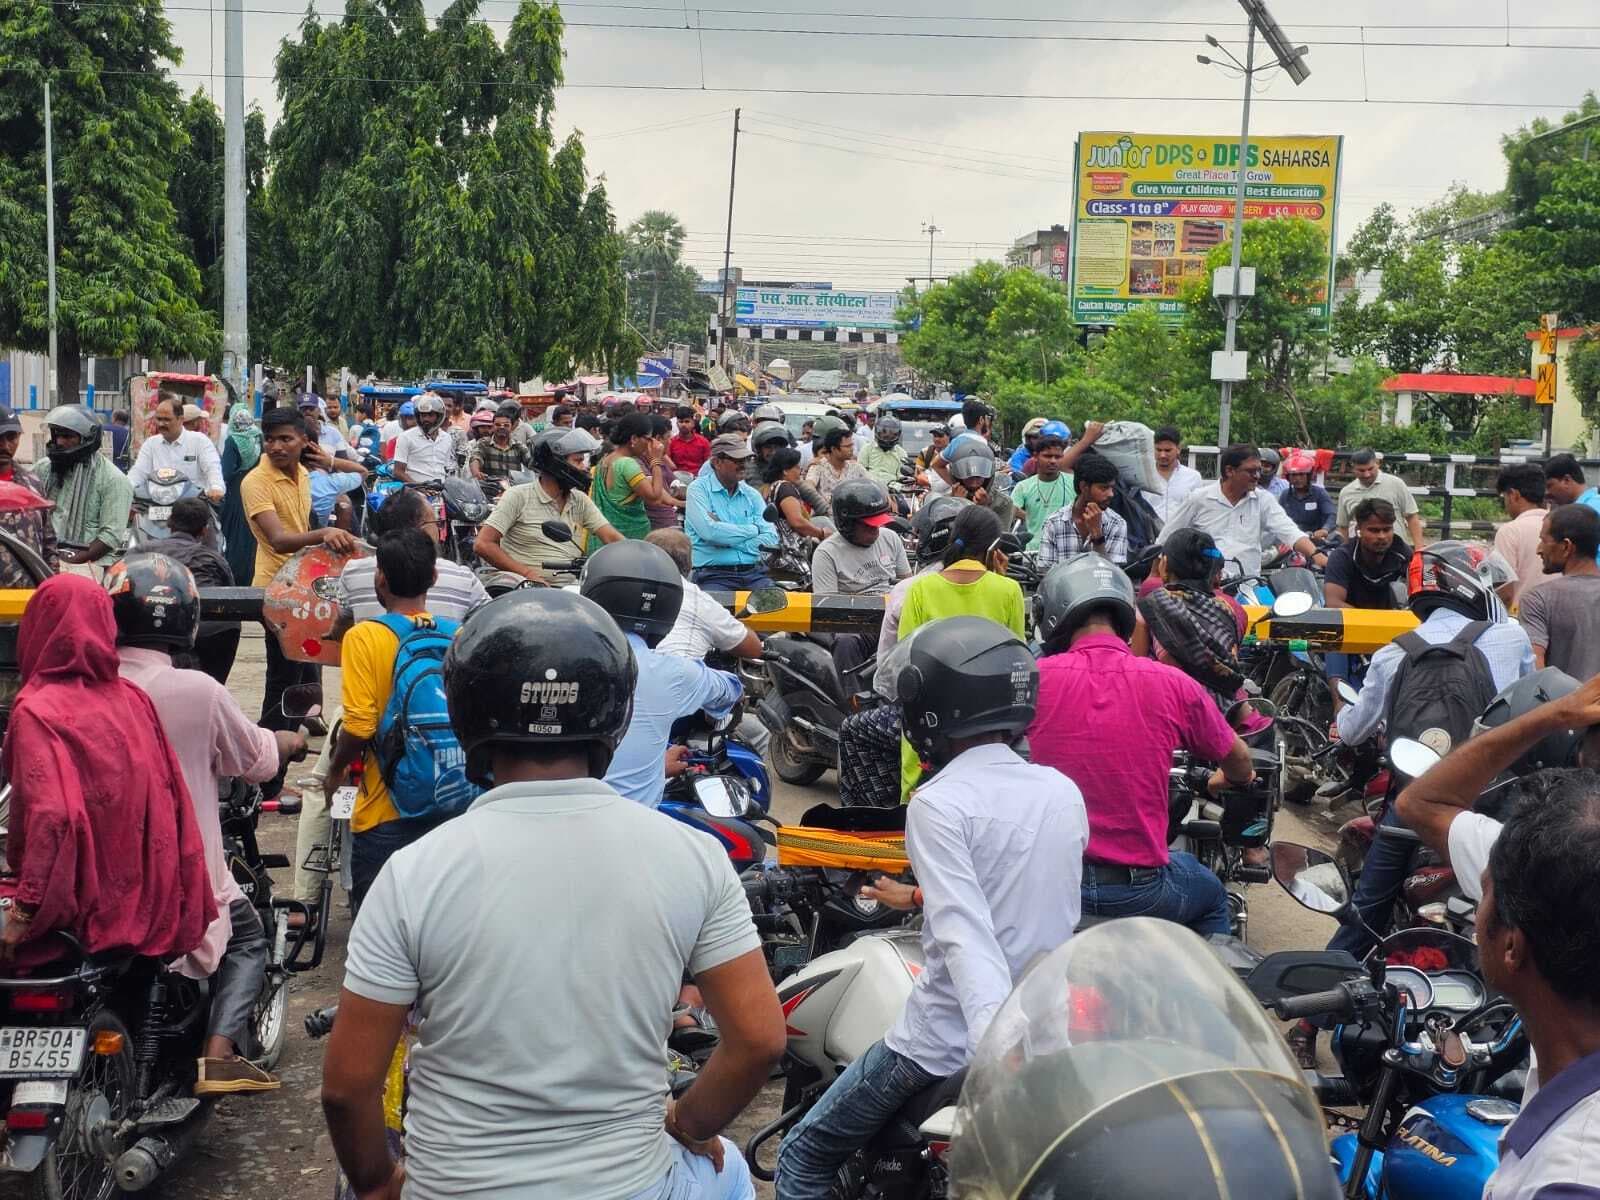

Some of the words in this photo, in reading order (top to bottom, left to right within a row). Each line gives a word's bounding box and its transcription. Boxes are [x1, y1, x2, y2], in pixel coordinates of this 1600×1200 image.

[1155, 143, 1194, 167] DPS
[1212, 143, 1259, 168] DPS
[1262, 149, 1330, 168] SAHARSA
[1175, 169, 1201, 181] Great
[1203, 169, 1229, 181] Place
[1246, 170, 1272, 182] Grow
[1136, 183, 1159, 195] Give
[1160, 183, 1184, 195] Your
[1185, 183, 1226, 196] Children
[1246, 187, 1269, 198] Best
[1270, 187, 1320, 198] Education
[1129, 203, 1136, 214] 1
[1138, 203, 1151, 214] to
[1180, 203, 1197, 214] PLAY
[1198, 203, 1224, 214] GROUP
[520, 682, 579, 704] STUDDS
[13, 1030, 73, 1048] BR50A
[8, 1050, 71, 1069] B5455
[1396, 1127, 1457, 1167] PLATINA
